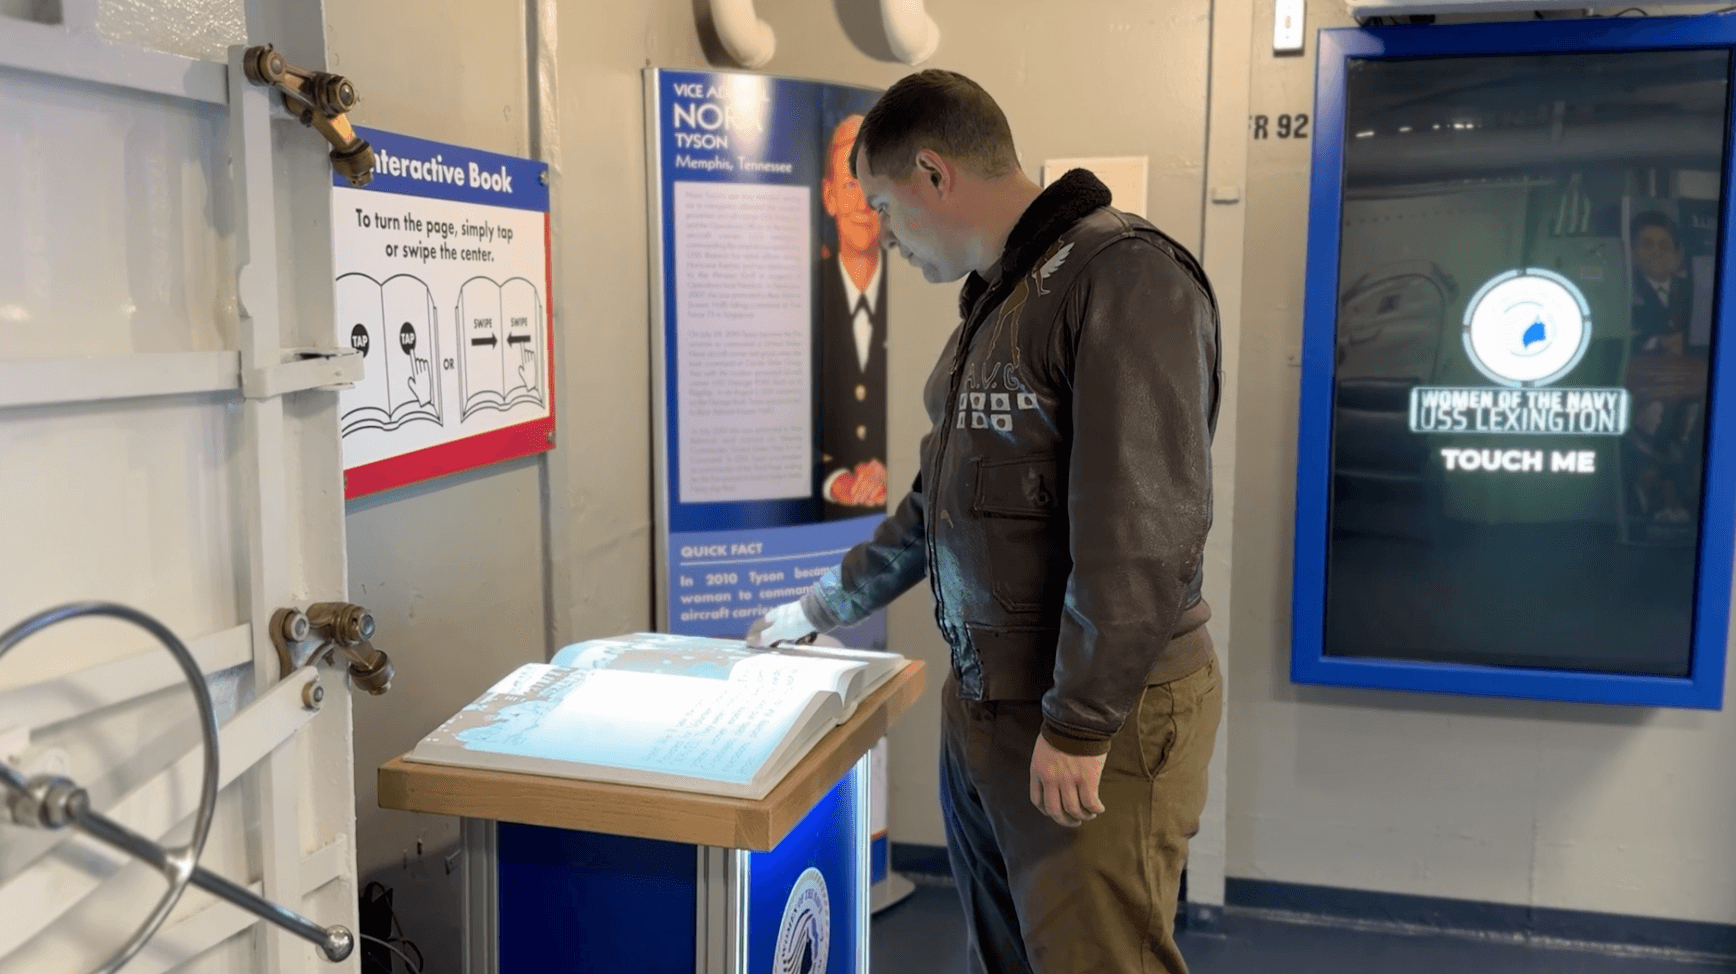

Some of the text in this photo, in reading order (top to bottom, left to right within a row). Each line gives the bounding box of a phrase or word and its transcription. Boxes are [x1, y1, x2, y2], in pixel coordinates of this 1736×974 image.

[673, 83, 704, 98] VICE
[1276, 113, 1310, 139] 92
[674, 132, 729, 150] TYSON
[372, 148, 513, 194] nteractive Book
[675, 154, 793, 173] Memphis, Tennessee
[355, 208, 513, 244] To turn the page, simply tap
[385, 241, 495, 264] or swipe the center.
[473, 318, 493, 329] SWIPE
[510, 317, 528, 327] SWIPE
[352, 334, 368, 348] TAP
[400, 332, 416, 345] TAP
[443, 358, 455, 371] OR
[1421, 390, 1618, 412] WOMEN OF THE NAVY
[1421, 407, 1616, 432] USS LEXINGTON
[1441, 448, 1596, 473] TOUCH ME
[681, 542, 763, 558] QUICK FACT
[680, 566, 832, 587] In 2010 Tyson becam
[680, 591, 731, 604] woman
[739, 589, 752, 601] to
[680, 603, 770, 621] aircraft carrie
